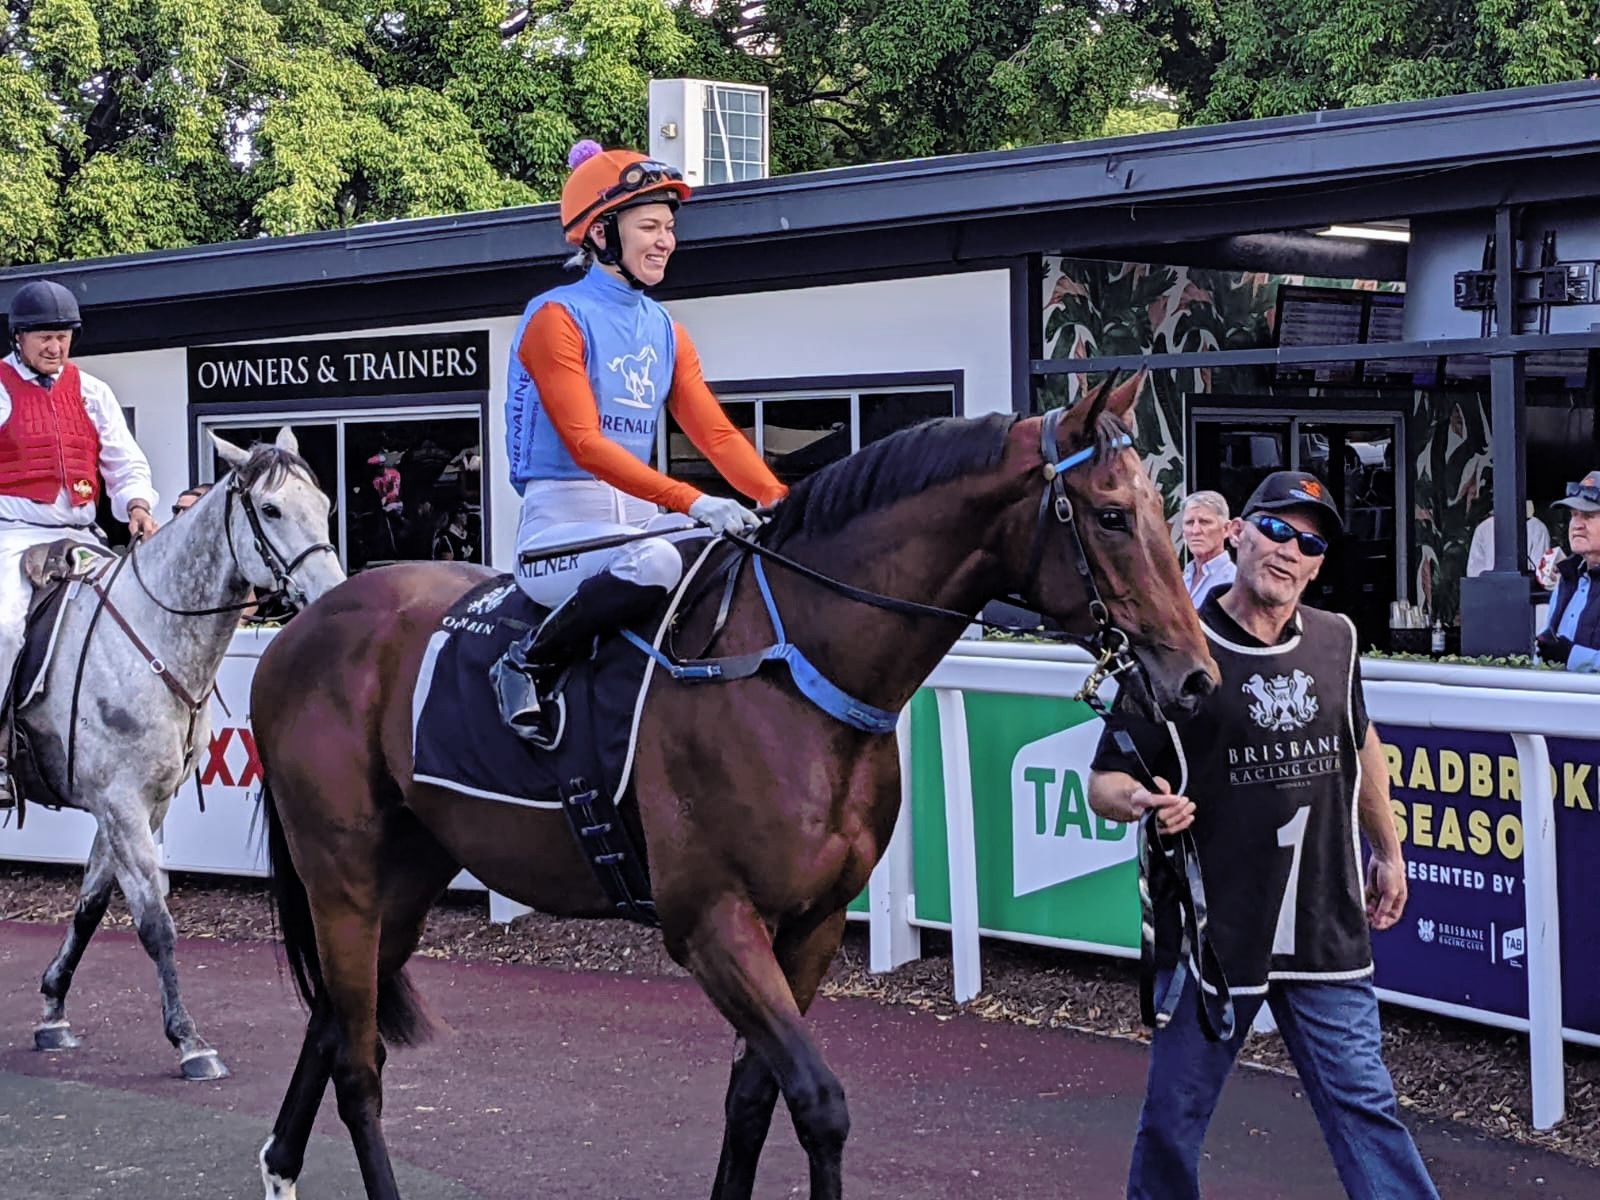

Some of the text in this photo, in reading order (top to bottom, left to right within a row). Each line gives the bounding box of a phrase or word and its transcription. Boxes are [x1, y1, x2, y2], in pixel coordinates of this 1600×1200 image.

[198, 347, 477, 388] OWNERS & TRAINERS
[1228, 735, 1341, 764] BRISBANE
[1230, 758, 1342, 784] RACING CLUB
[1272, 806, 1312, 955] 1
[1493, 876, 1515, 894] BY
[1438, 923, 1484, 940] BRISBANE
[1505, 936, 1523, 951] TAB
